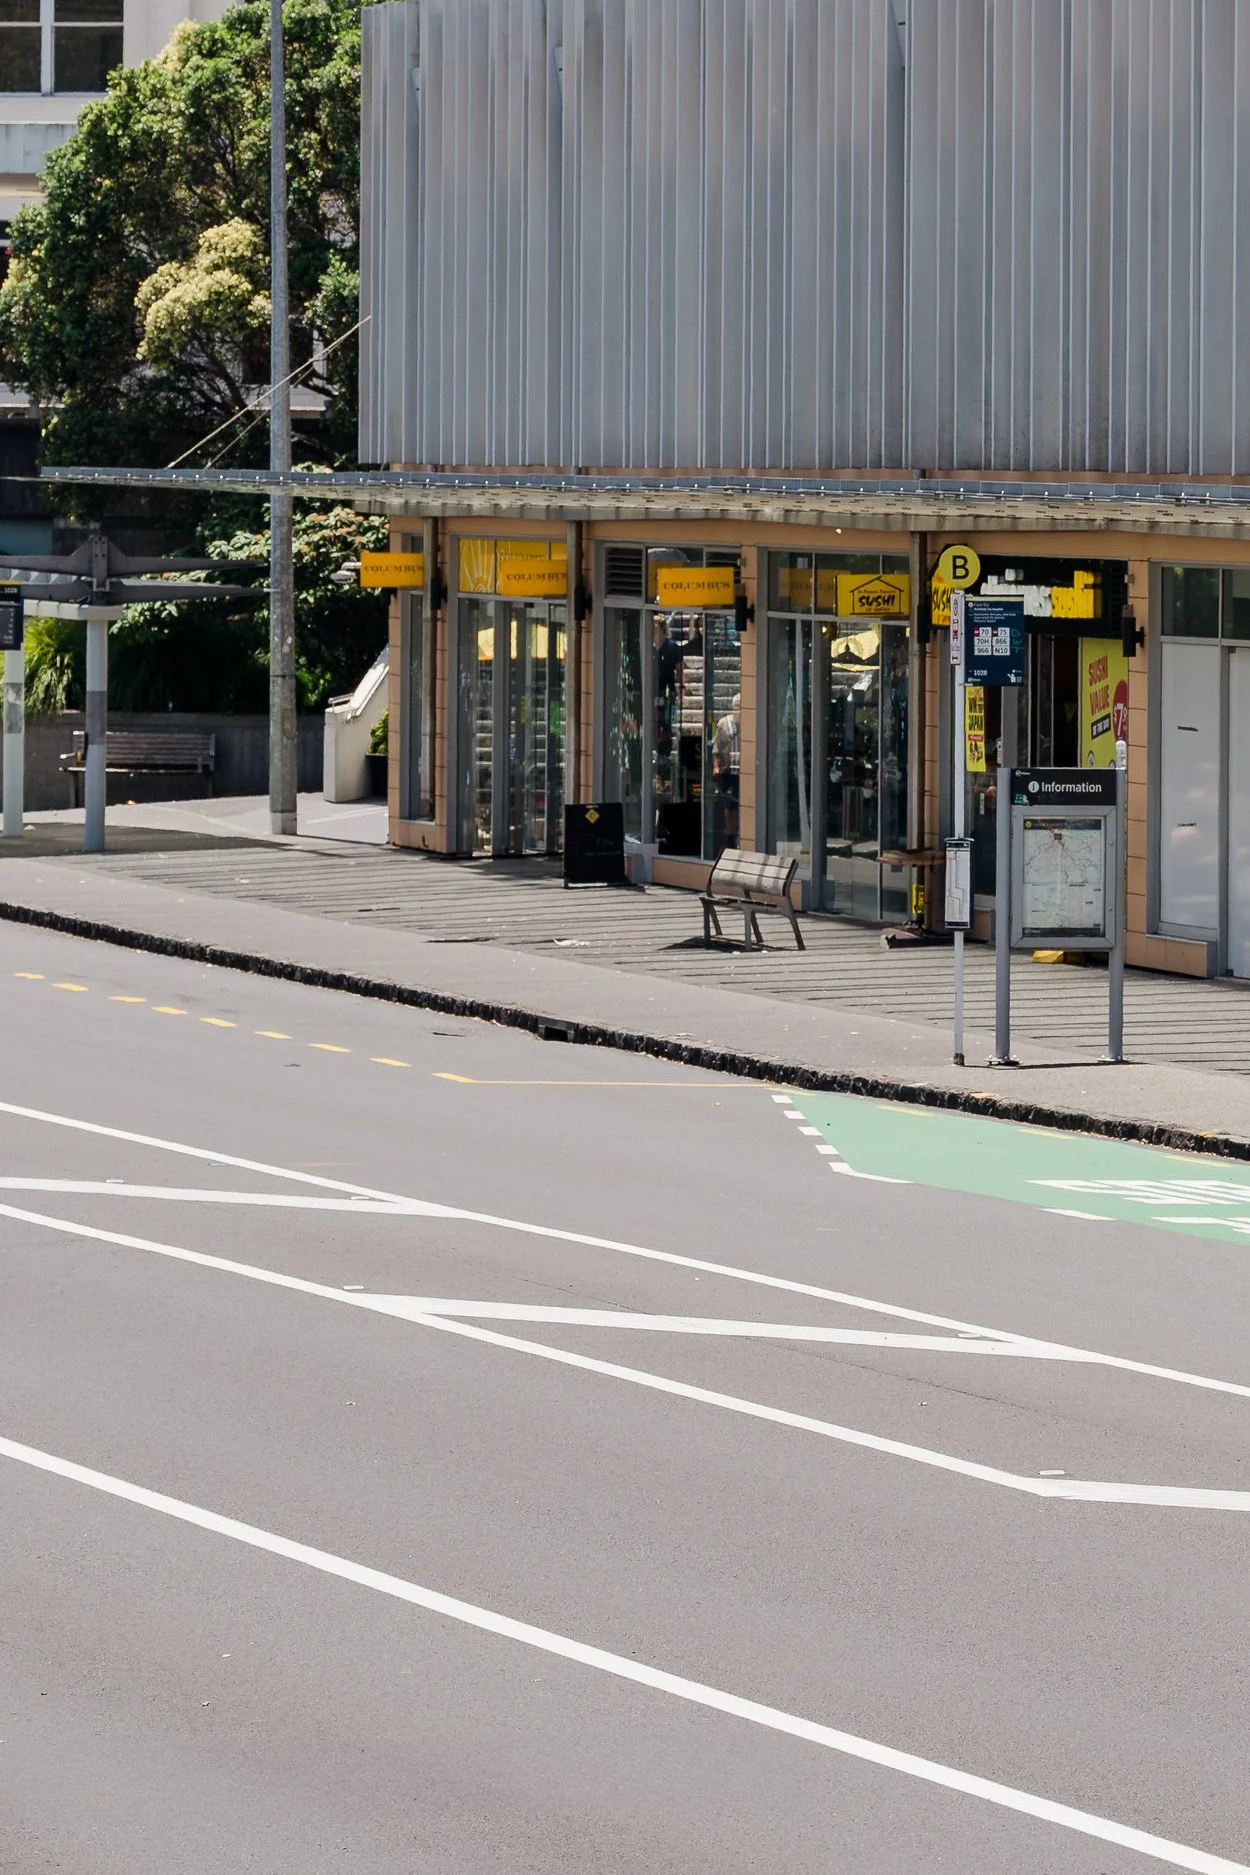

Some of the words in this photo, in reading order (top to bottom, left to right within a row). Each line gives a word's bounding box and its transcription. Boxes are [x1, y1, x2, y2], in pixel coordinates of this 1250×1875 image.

[364, 565, 424, 573] COLUMBUS
[952, 555, 969, 579] B
[506, 572, 568, 581] COLUMBUS
[663, 582, 731, 590] COLUMBUS
[858, 594, 895, 607] SUSHI
[1051, 571, 1094, 619] sushi
[1088, 655, 1108, 686] SUSHI
[1089, 684, 1110, 716] VALUE
[968, 715, 984, 731] JAPAN
[1041, 781, 1102, 793] Information
